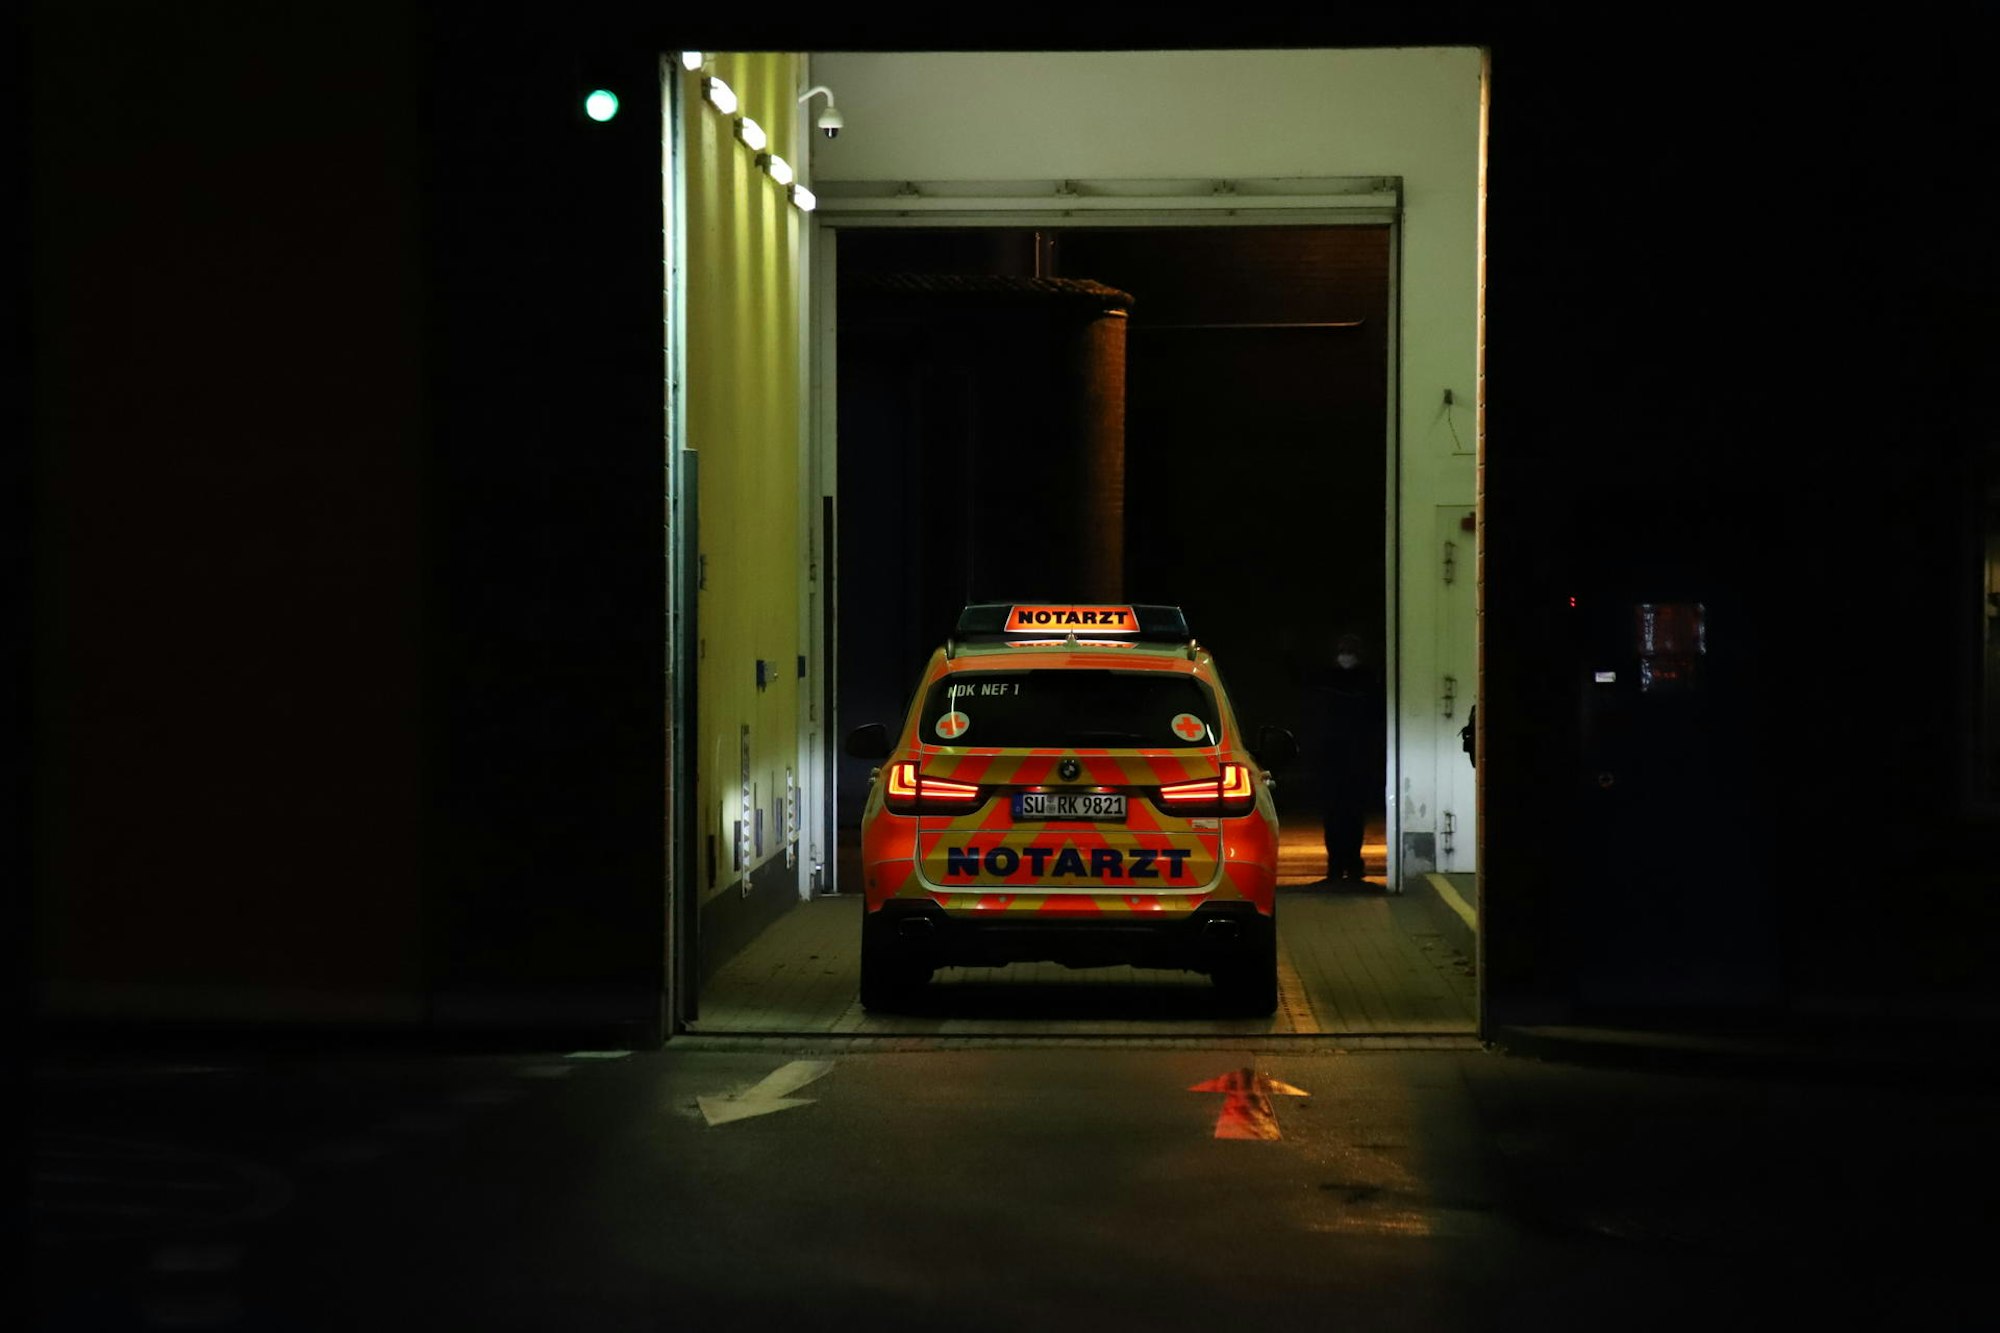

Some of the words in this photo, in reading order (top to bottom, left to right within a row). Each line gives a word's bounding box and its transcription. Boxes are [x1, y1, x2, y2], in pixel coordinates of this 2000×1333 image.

[1018, 611, 1128, 624] NOTARZT
[981, 684, 1009, 696] NEF
[1024, 796, 1044, 813] SU
[1058, 796, 1077, 813] RK
[1083, 797, 1123, 814] 9821
[948, 847, 1191, 877] NOTARZT
